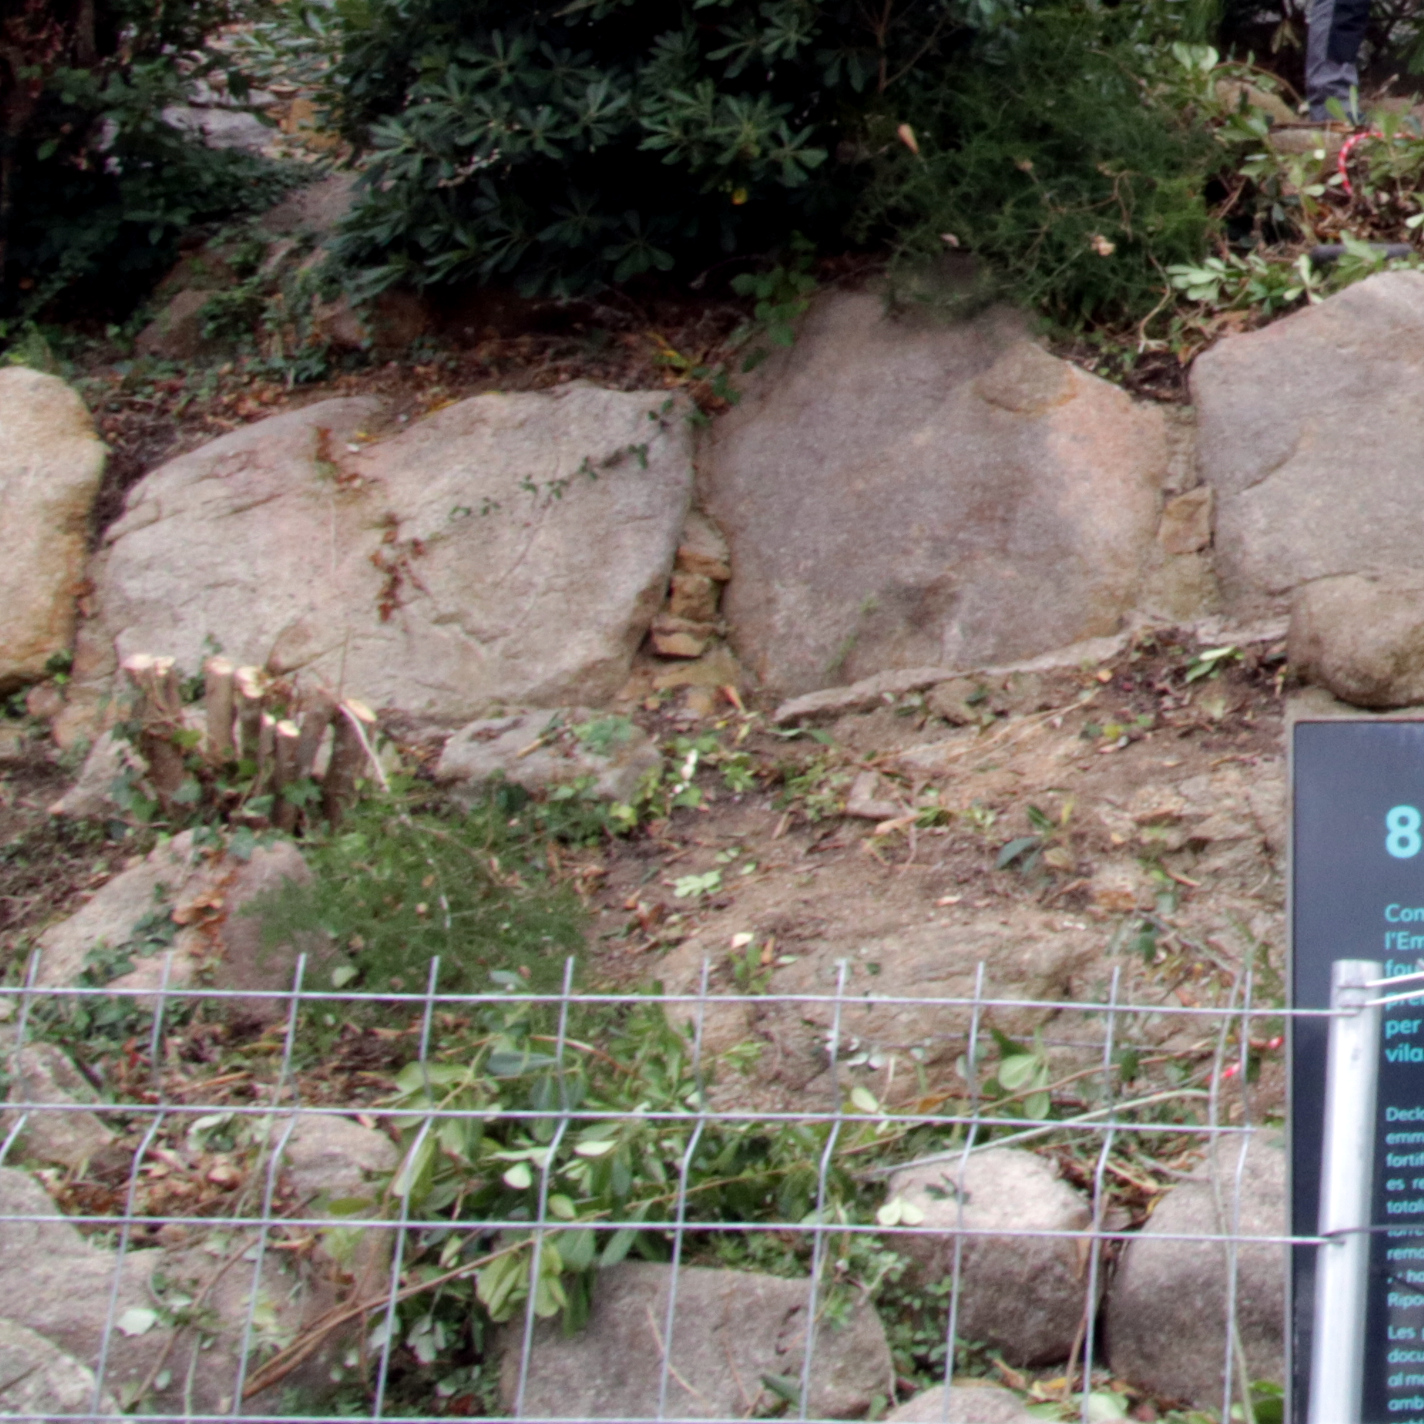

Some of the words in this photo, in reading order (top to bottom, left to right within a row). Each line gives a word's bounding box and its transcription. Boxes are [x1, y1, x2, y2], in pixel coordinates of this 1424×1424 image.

[1385, 1018, 1422, 1039] per
[1386, 1178, 1405, 1192] es
[1387, 1325, 1417, 1341] Les
[1387, 1371, 1404, 1388] al
